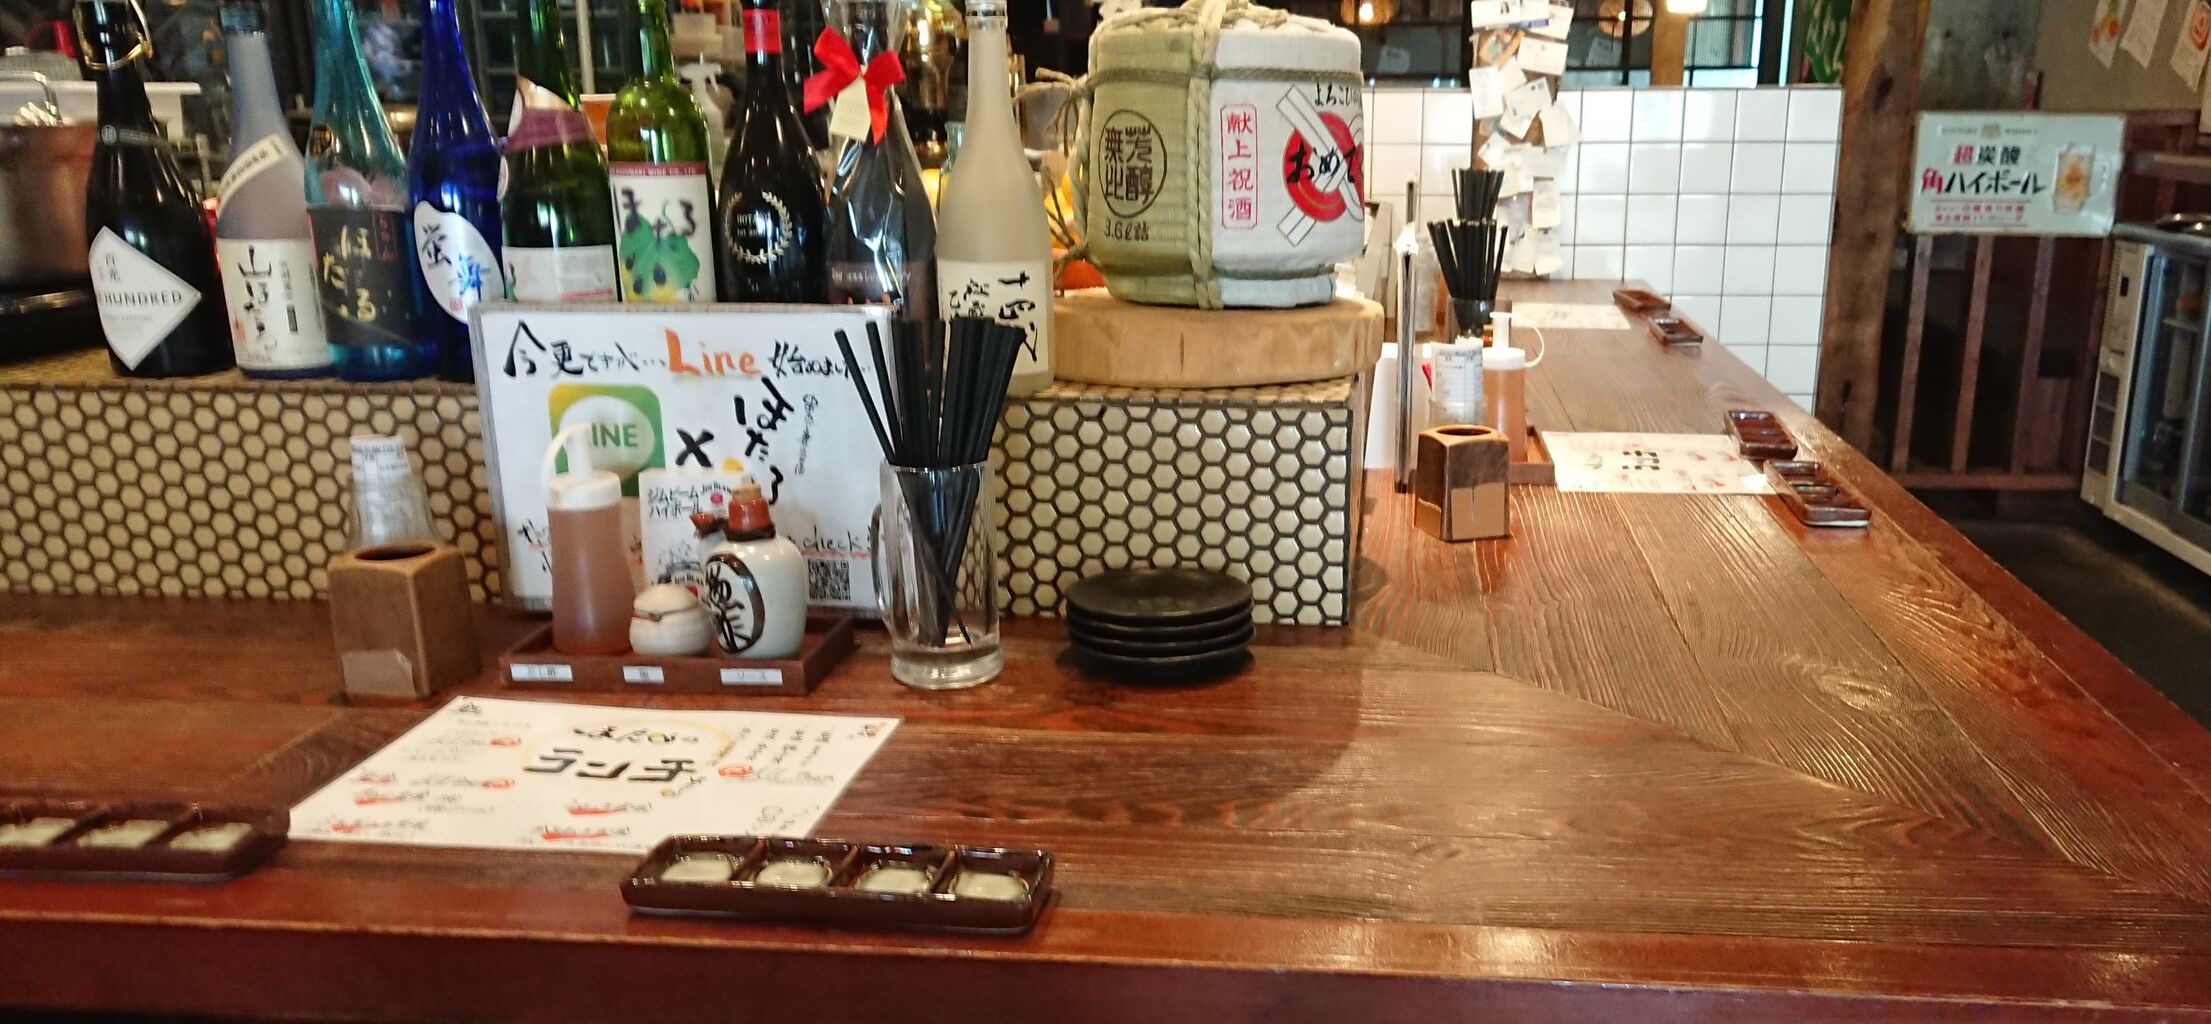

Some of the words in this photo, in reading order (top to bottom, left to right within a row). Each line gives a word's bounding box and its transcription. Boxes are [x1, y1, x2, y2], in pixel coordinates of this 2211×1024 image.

[1227, 112, 1253, 221] 献上祝酒
[1953, 144, 2021, 165] 超炭酸
[1921, 168, 2046, 195] 角ハイボール
[103, 289, 182, 306] HUNDRED
[664, 327, 762, 376] Line
[590, 421, 639, 448] INE
[648, 499, 700, 520] ハイボール
